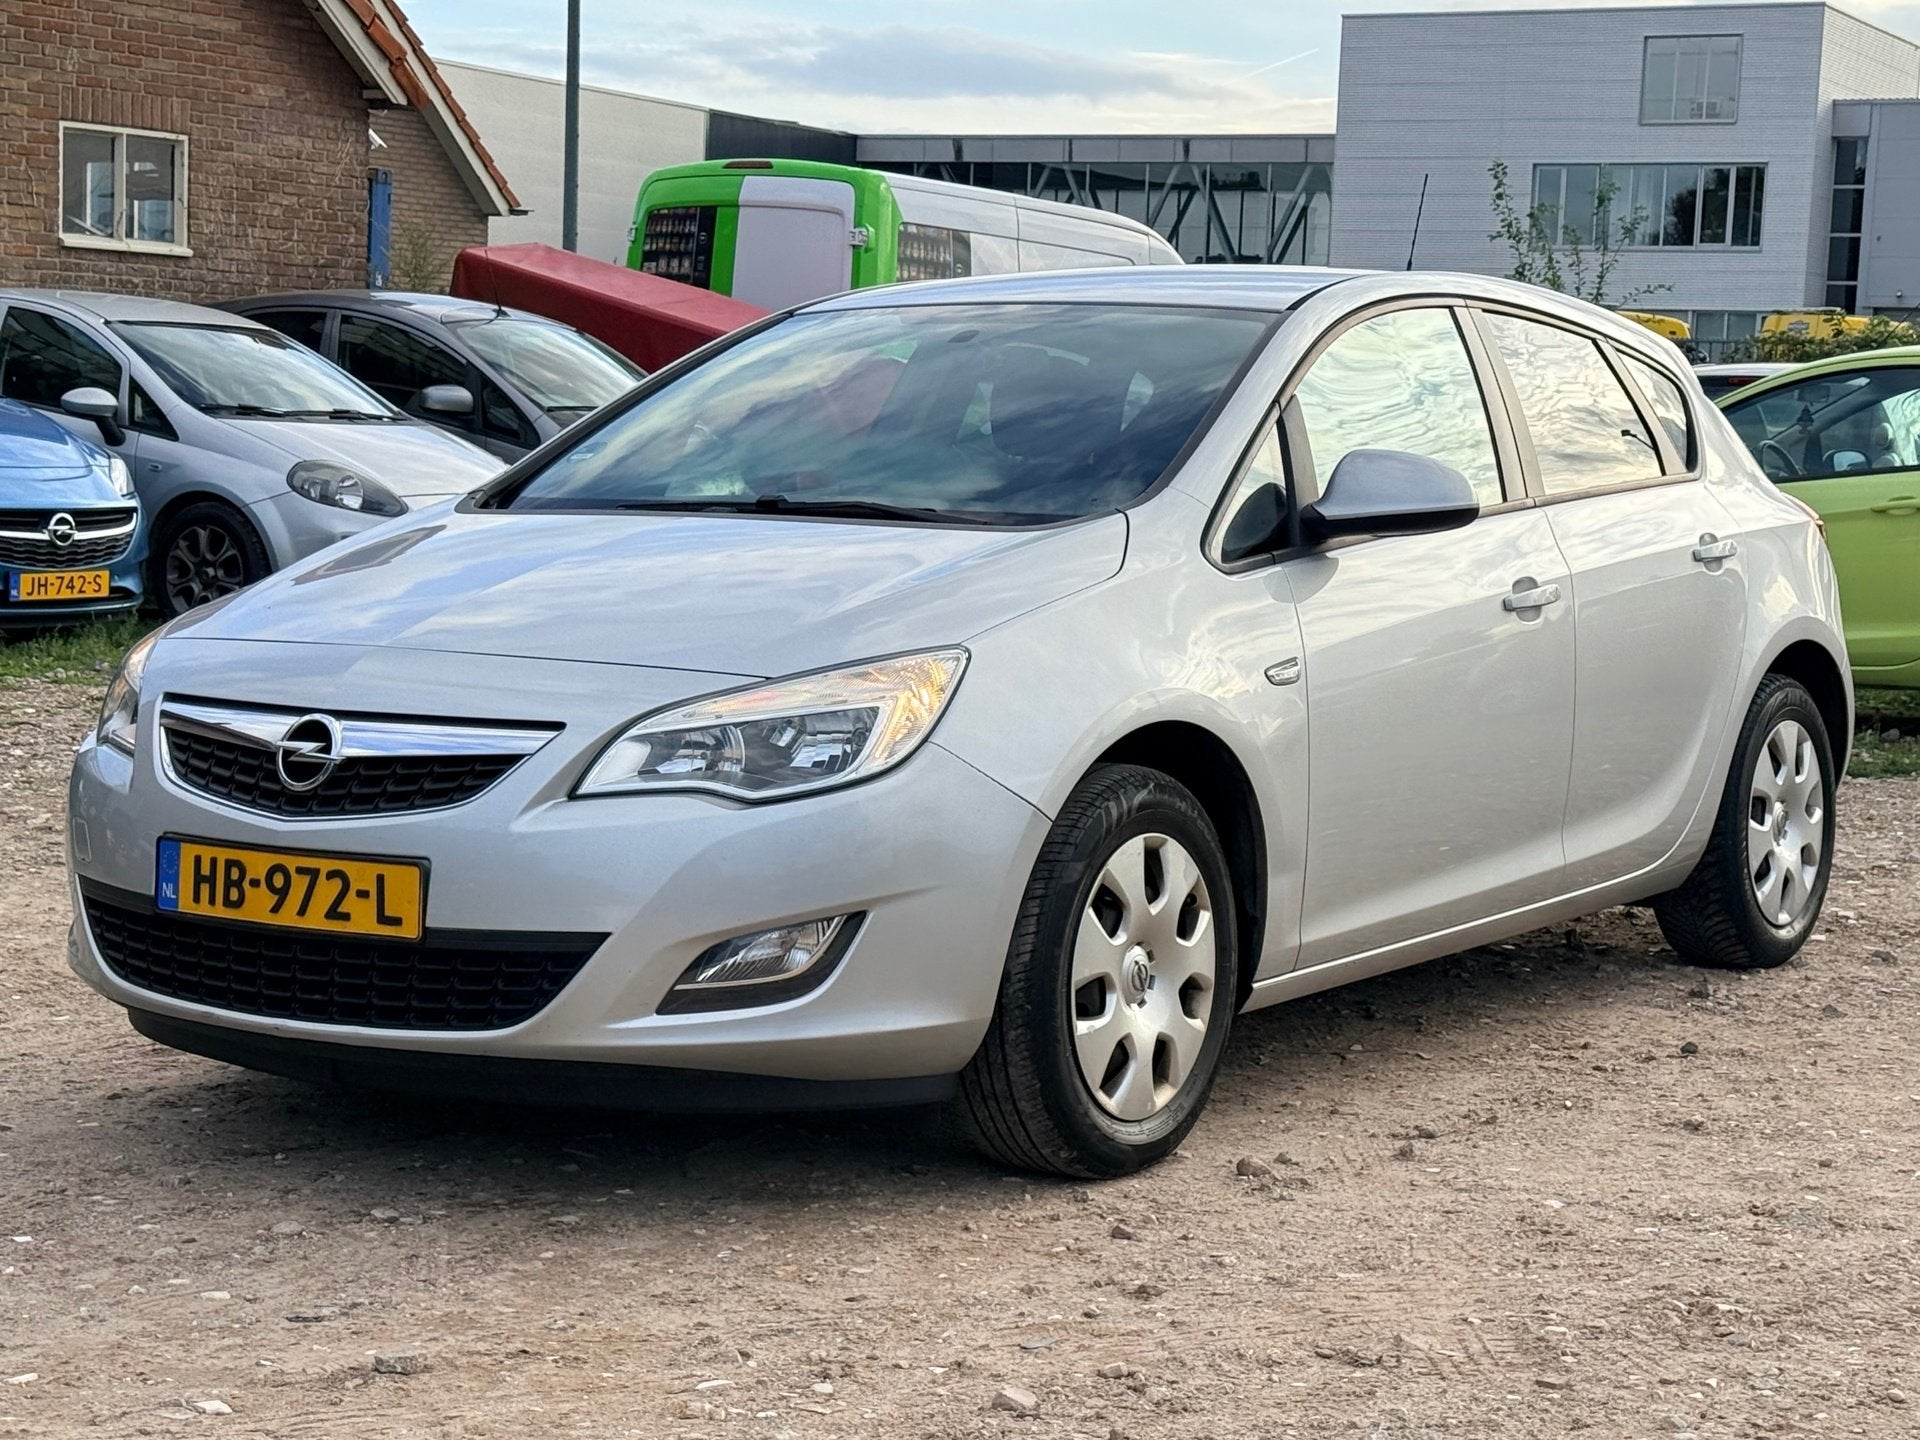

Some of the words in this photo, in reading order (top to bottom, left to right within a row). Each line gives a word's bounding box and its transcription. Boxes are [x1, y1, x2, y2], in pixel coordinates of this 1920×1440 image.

[26, 574, 102, 596] JH-742-S
[162, 882, 177, 899] NL
[192, 854, 403, 926] HB-972-L
